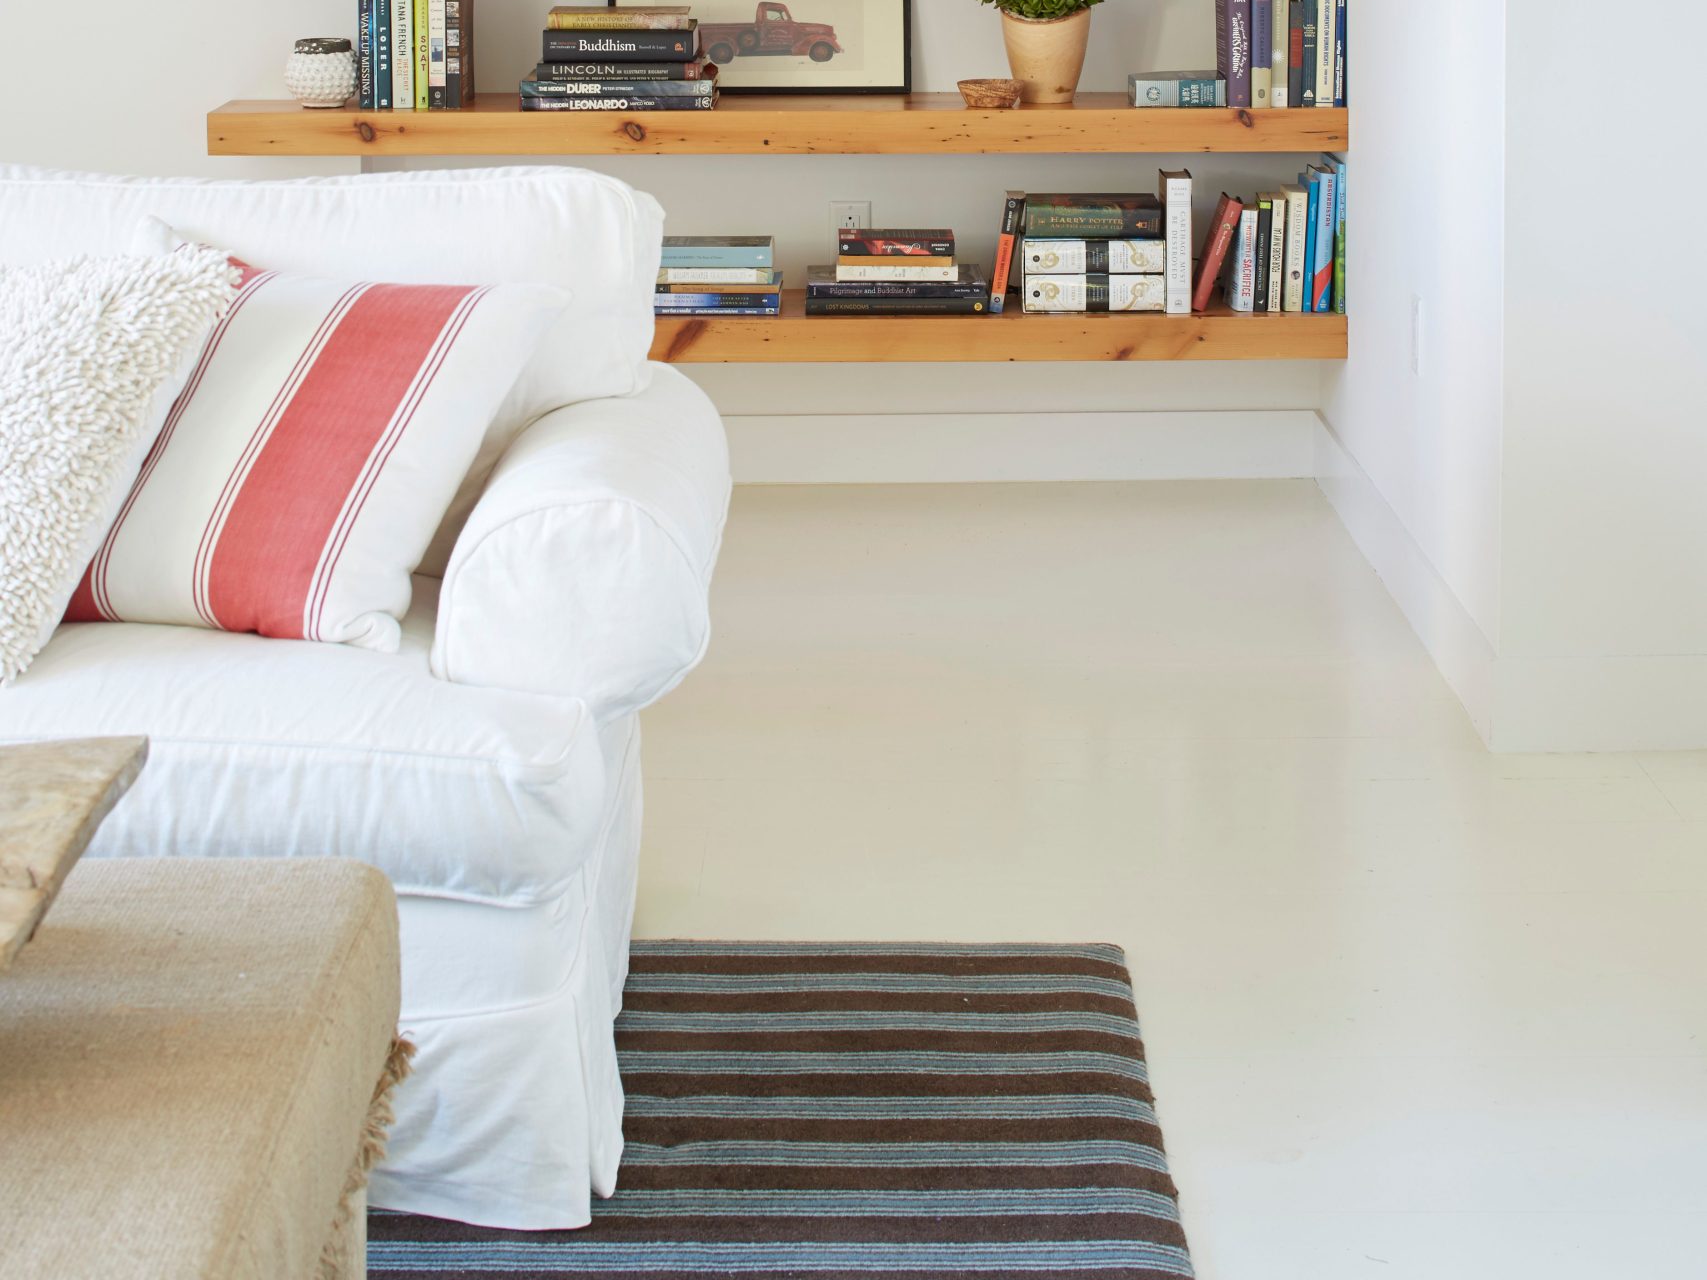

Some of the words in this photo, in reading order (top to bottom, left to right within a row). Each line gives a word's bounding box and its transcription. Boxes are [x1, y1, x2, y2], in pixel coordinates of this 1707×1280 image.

[397, 1, 406, 22] TANA
[1323, 4, 1331, 29] DOCUMENTS
[361, 12, 370, 41] WAKE
[1232, 17, 1241, 46] BROTHERS
[397, 24, 406, 56] FRENCH
[578, 39, 637, 52] Buddhism
[1323, 36, 1331, 51] HUMAN
[361, 41, 370, 55] UP
[1232, 47, 1241, 73] GRIMM
[1323, 51, 1331, 66] RIGHTS
[361, 56, 370, 95] MISSING
[552, 65, 615, 75] LINCOLN
[566, 83, 601, 94] DÜRER
[569, 99, 628, 110] LEONARDO
[1325, 179, 1333, 227] ABSURDISTAN
[1171, 216, 1178, 225] BE
[1245, 225, 1253, 258] MIDWINTER
[1273, 234, 1282, 242] MY
[1272, 247, 1281, 261] HOURS
[1271, 261, 1281, 273] FOUR
[1242, 258, 1252, 297] SACRIFICE
[830, 287, 862, 295] Pilgrimage
[863, 287, 876, 295] and
[877, 287, 904, 295] Buddhist
[905, 287, 916, 295] Art
